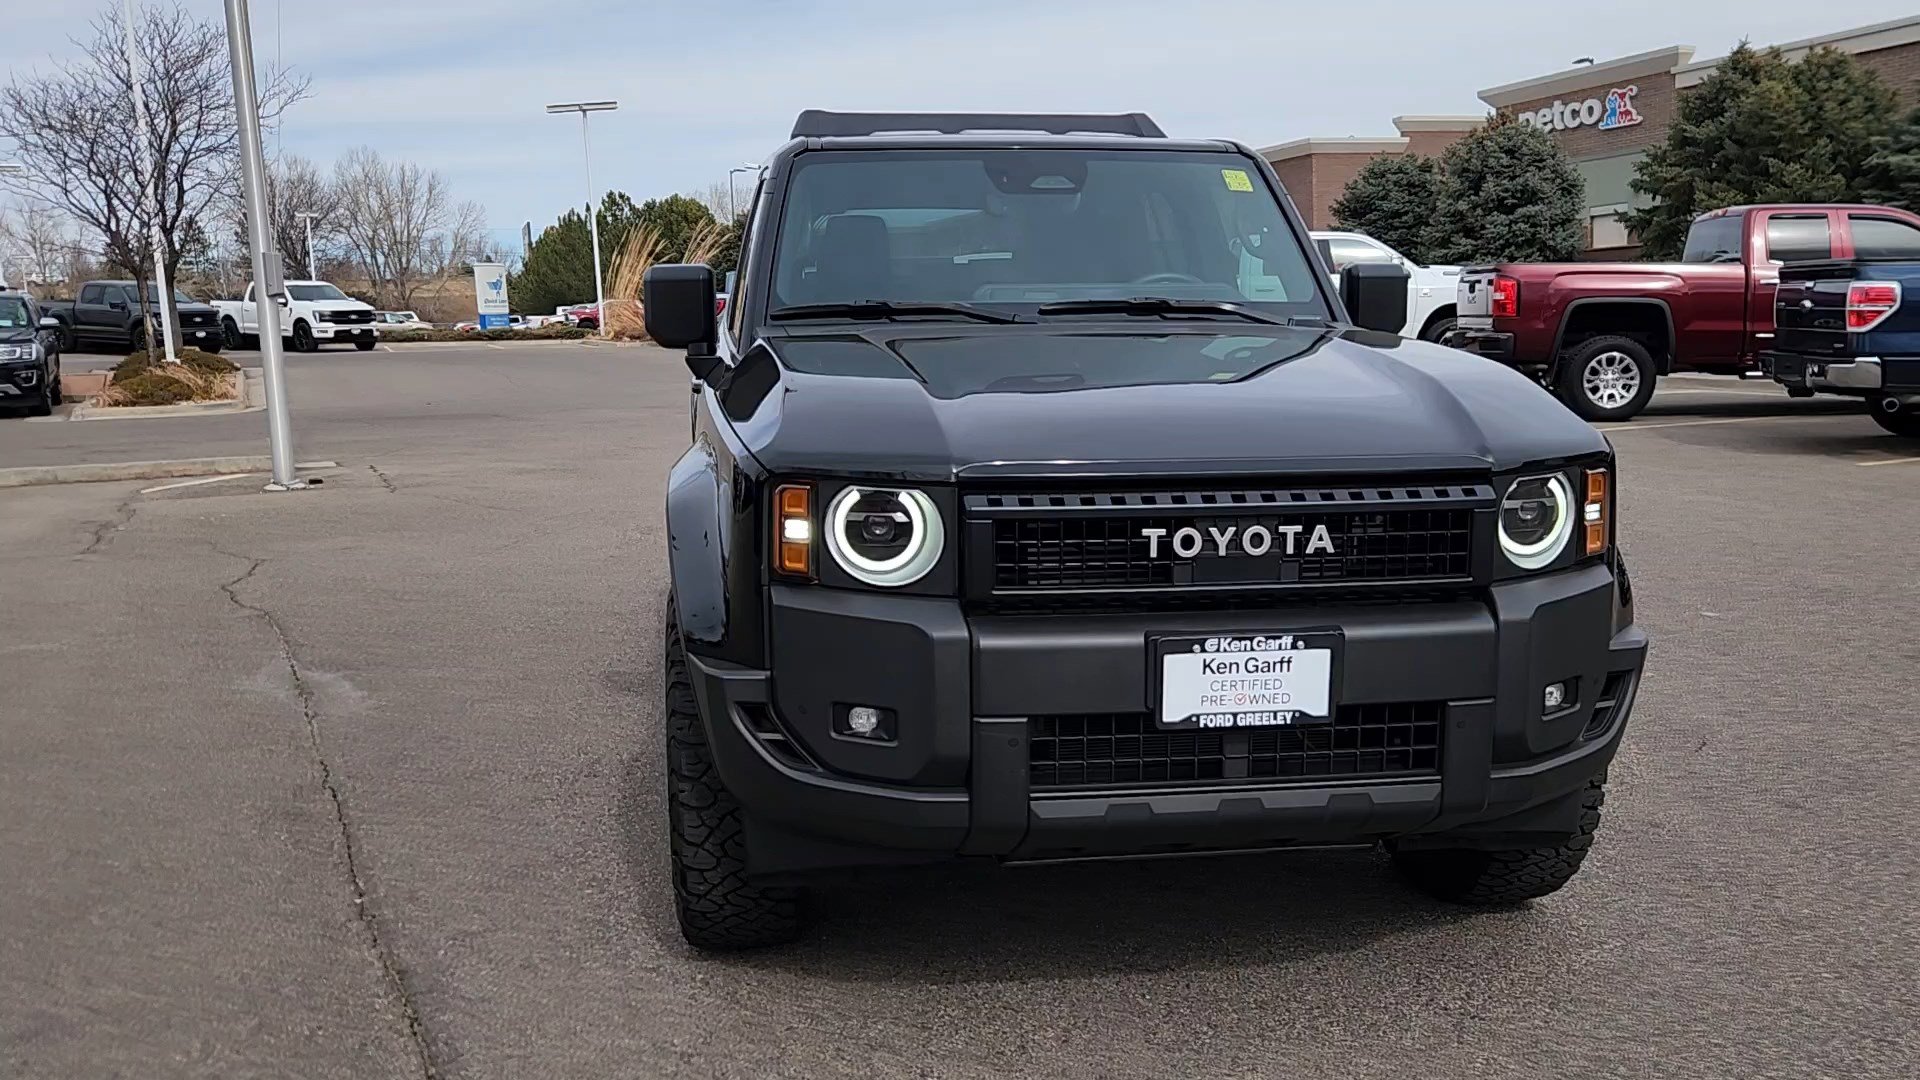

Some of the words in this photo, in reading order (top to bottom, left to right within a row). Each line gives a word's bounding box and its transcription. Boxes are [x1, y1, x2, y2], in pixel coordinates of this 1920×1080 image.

[1141, 524, 1335, 558] TOYOTA
[1220, 637, 1250, 652] Ken
[1252, 636, 1293, 650] Garff
[1202, 657, 1240, 675] Ken
[1244, 656, 1293, 673] Garff
[1210, 679, 1283, 692] CERTIFIED
[1199, 713, 1233, 728] FORD
[1236, 711, 1293, 725] GREELEY
